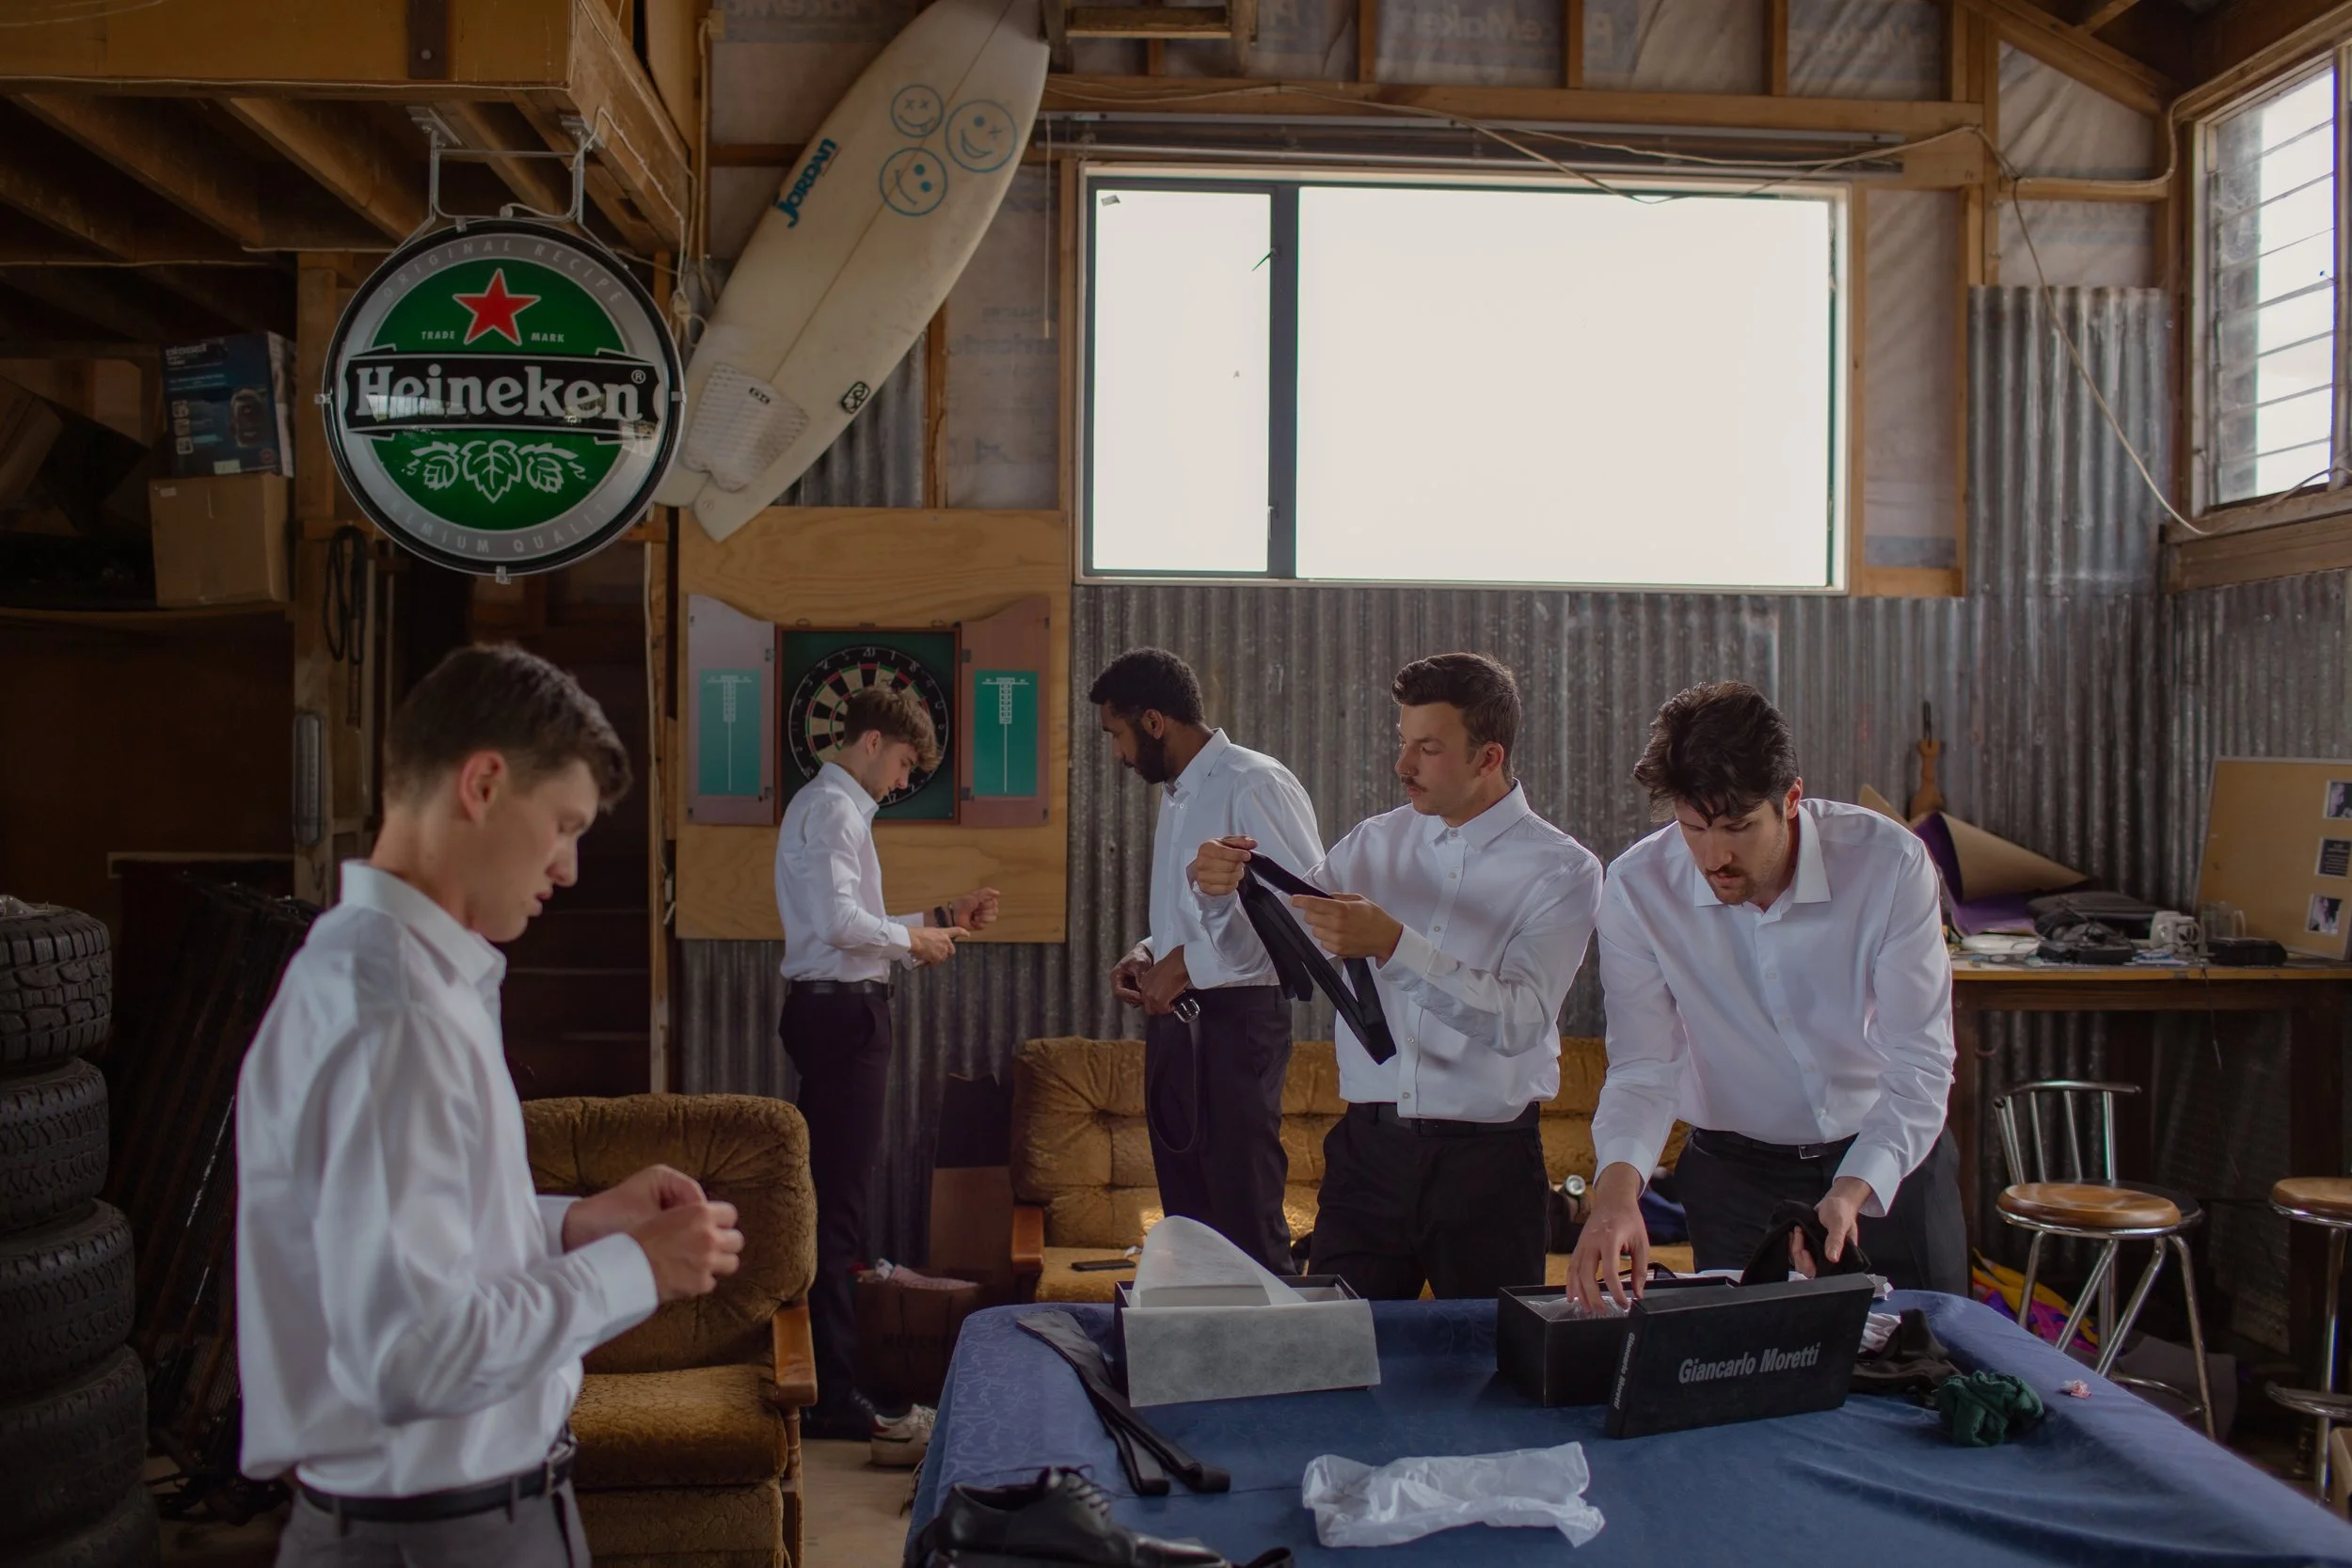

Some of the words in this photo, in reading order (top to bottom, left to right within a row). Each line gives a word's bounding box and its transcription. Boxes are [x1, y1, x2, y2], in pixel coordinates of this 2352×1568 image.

[382, 238, 513, 299] ORIGINAL
[532, 243, 624, 304] RECIPE
[421, 330, 456, 341] TRADE
[530, 332, 565, 343] MARK
[388, 501, 490, 554] REMIUM
[512, 503, 609, 554] QUALIT
[1678, 1351, 1756, 1384] Giancarlo
[1758, 1341, 1821, 1373] Moretti
